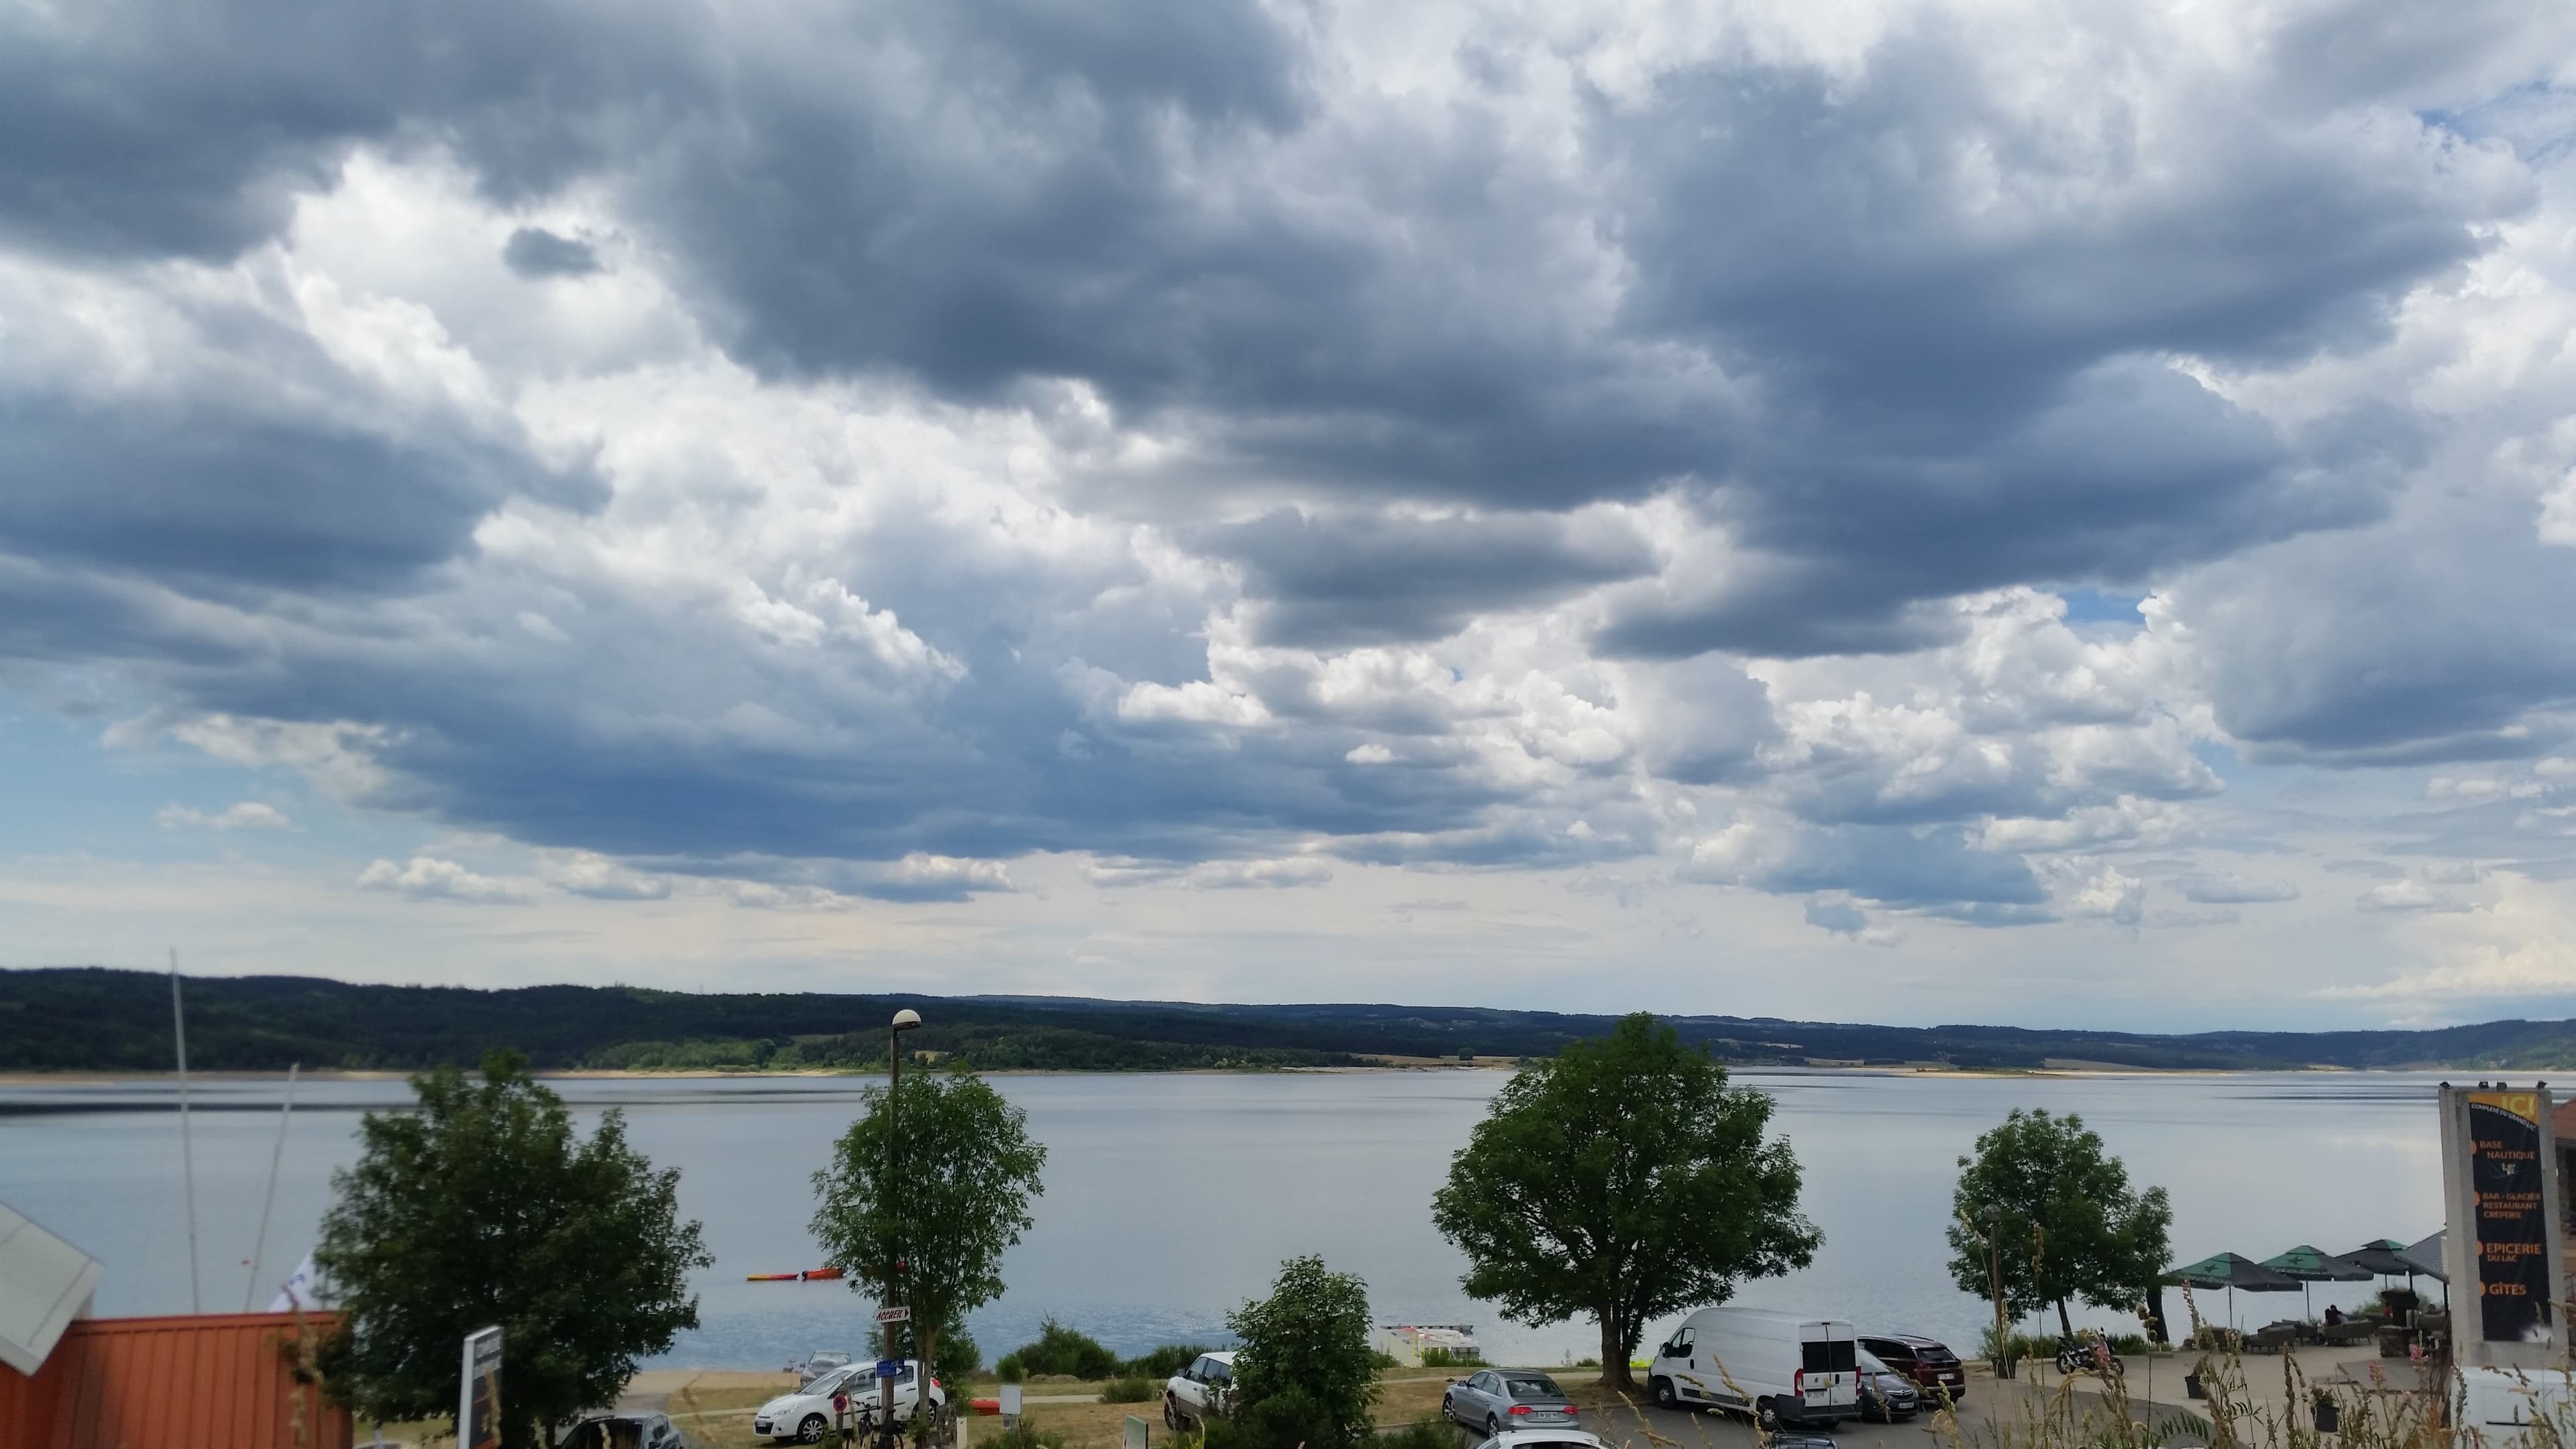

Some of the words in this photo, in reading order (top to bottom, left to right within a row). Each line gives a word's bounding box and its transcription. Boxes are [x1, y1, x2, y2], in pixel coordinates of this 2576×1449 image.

[2502, 1095, 2534, 1116] ICI
[2471, 1103, 2500, 1114] COMPLEXE
[2508, 1113, 2527, 1125] GRAND
[2526, 1123, 2536, 1132] LAC
[2487, 1151, 2534, 1160] NAUTIQUE
[2486, 1243, 2542, 1255] EPICERIE
[2489, 1281, 2526, 1295] GÎTES
[876, 1309, 903, 1321] ACCUEIL
